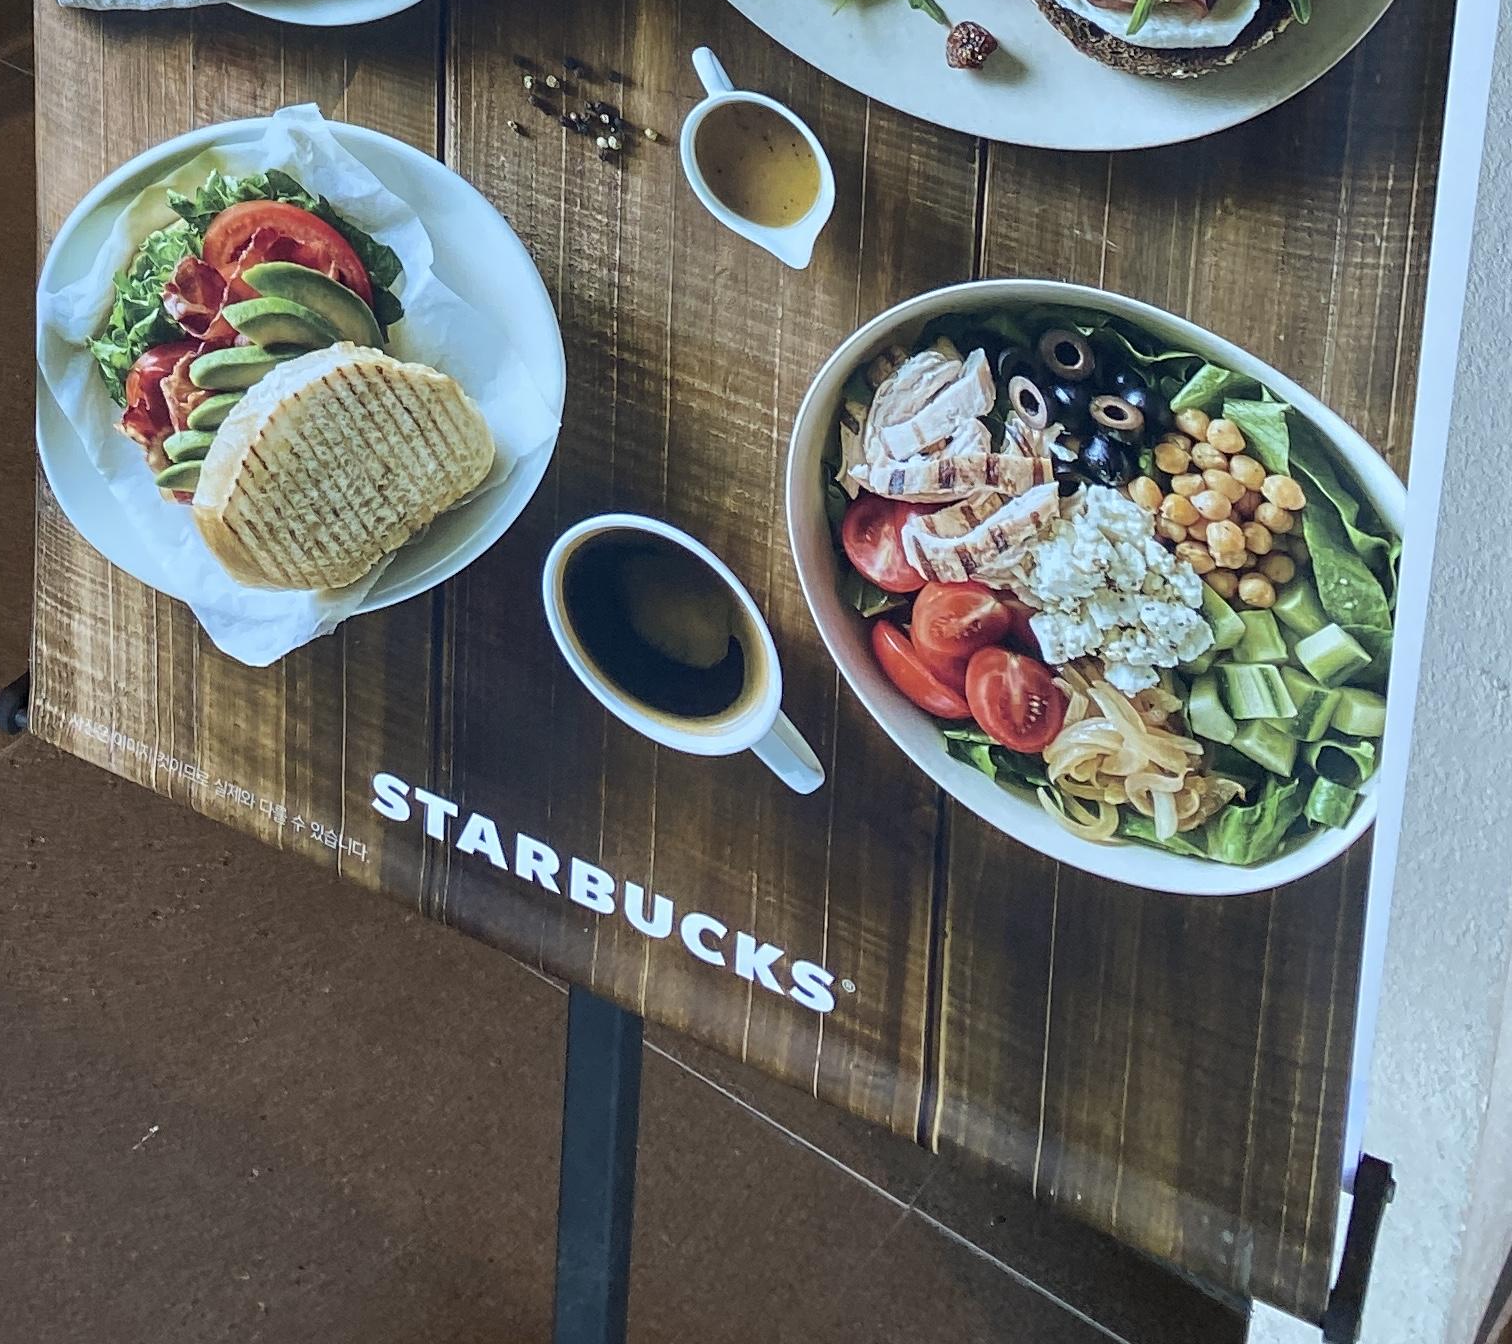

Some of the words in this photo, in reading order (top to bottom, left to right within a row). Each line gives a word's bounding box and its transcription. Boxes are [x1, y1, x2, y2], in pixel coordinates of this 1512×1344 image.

[214, 777, 256, 810] 실제와
[259, 797, 288, 826] 다를
[290, 814, 306, 833] 수
[310, 821, 370, 865] 있습니다.
